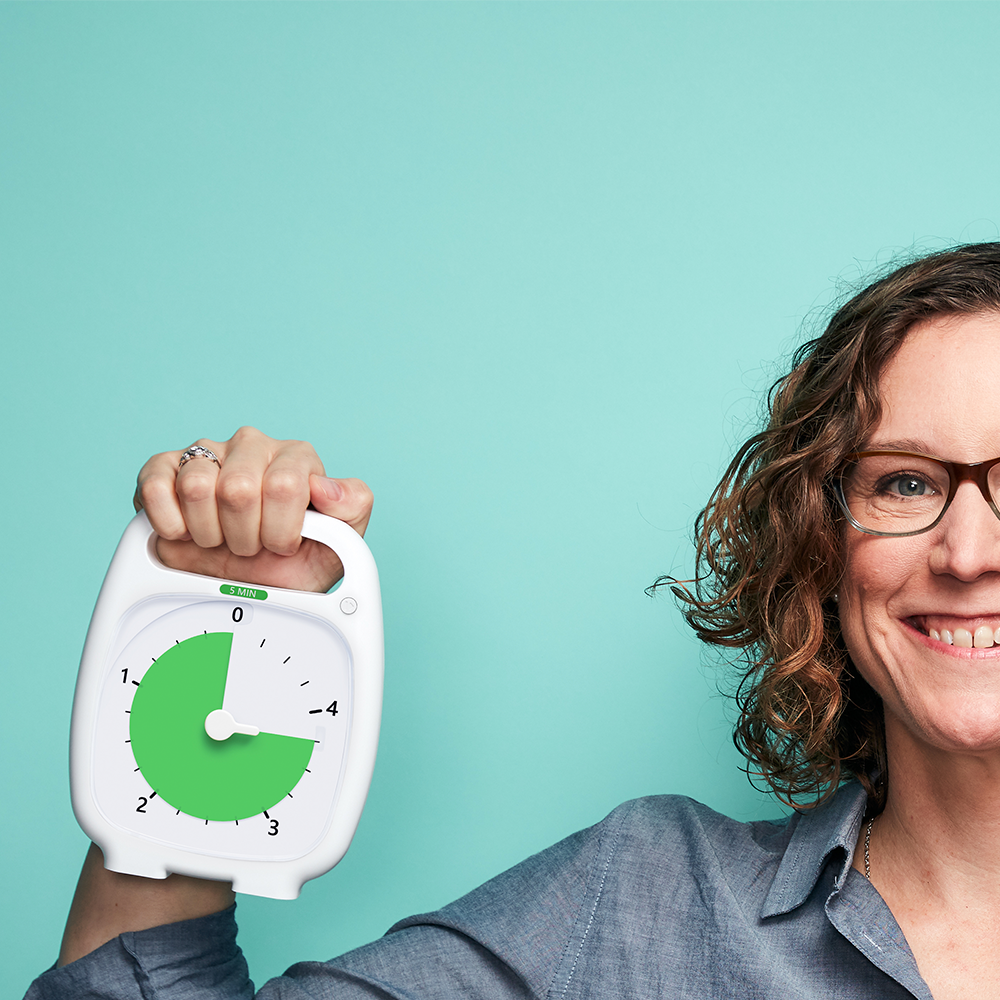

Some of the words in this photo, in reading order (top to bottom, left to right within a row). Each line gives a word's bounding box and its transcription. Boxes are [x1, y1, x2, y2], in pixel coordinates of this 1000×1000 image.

[230, 586, 235, 595] 5
[237, 587, 257, 598] MIN
[231, 606, 244, 623] 0
[121, 667, 129, 684] 1
[325, 700, 339, 717] 4
[135, 796, 148, 814] 2
[267, 819, 280, 836] 3
